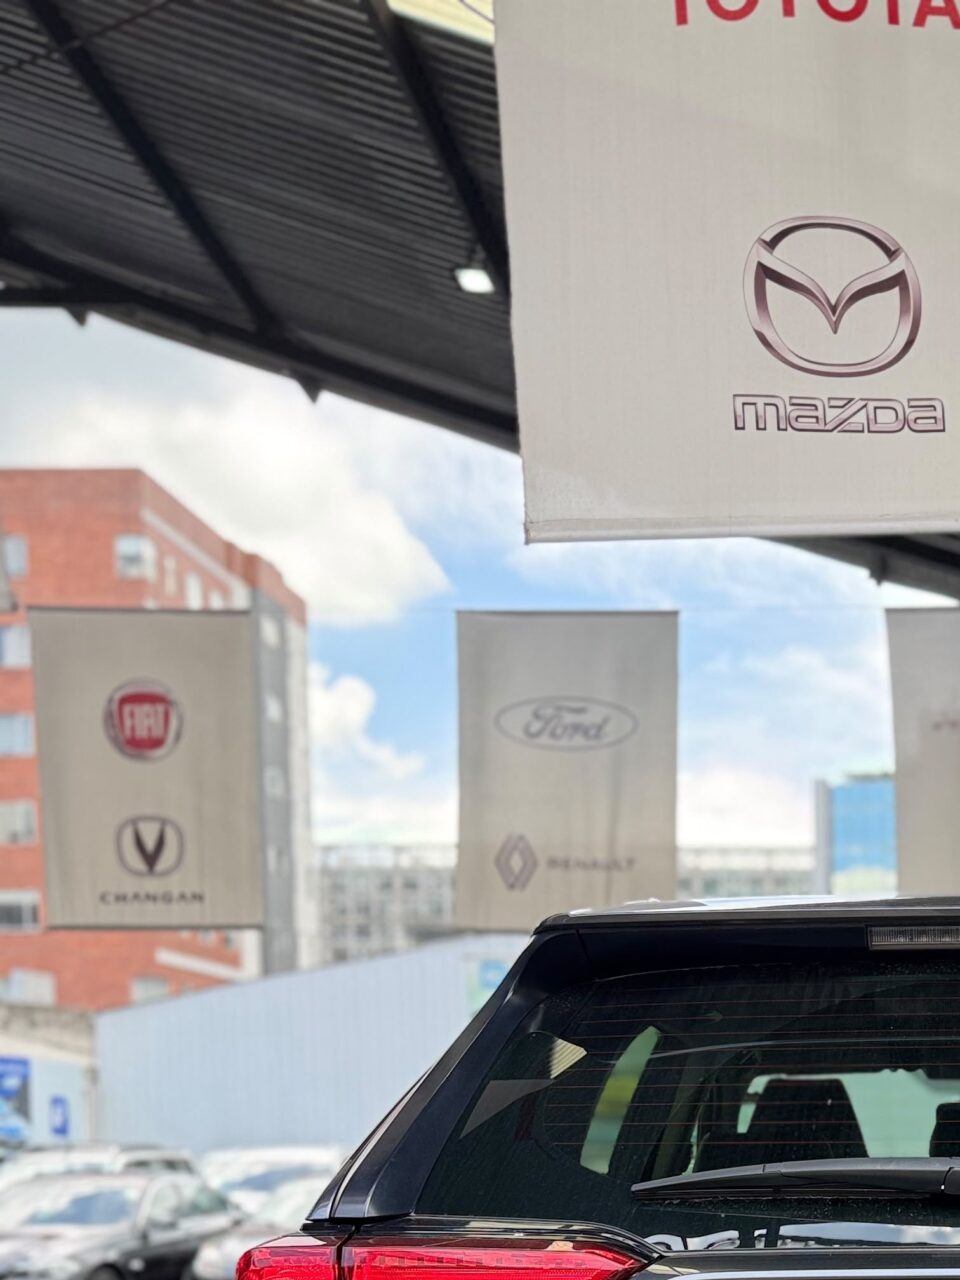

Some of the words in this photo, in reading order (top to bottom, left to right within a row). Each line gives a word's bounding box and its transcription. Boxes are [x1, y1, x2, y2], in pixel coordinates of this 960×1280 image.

[121, 702, 166, 740] FIAT
[523, 703, 612, 740] Ford
[99, 891, 205, 905] CHANGAN
